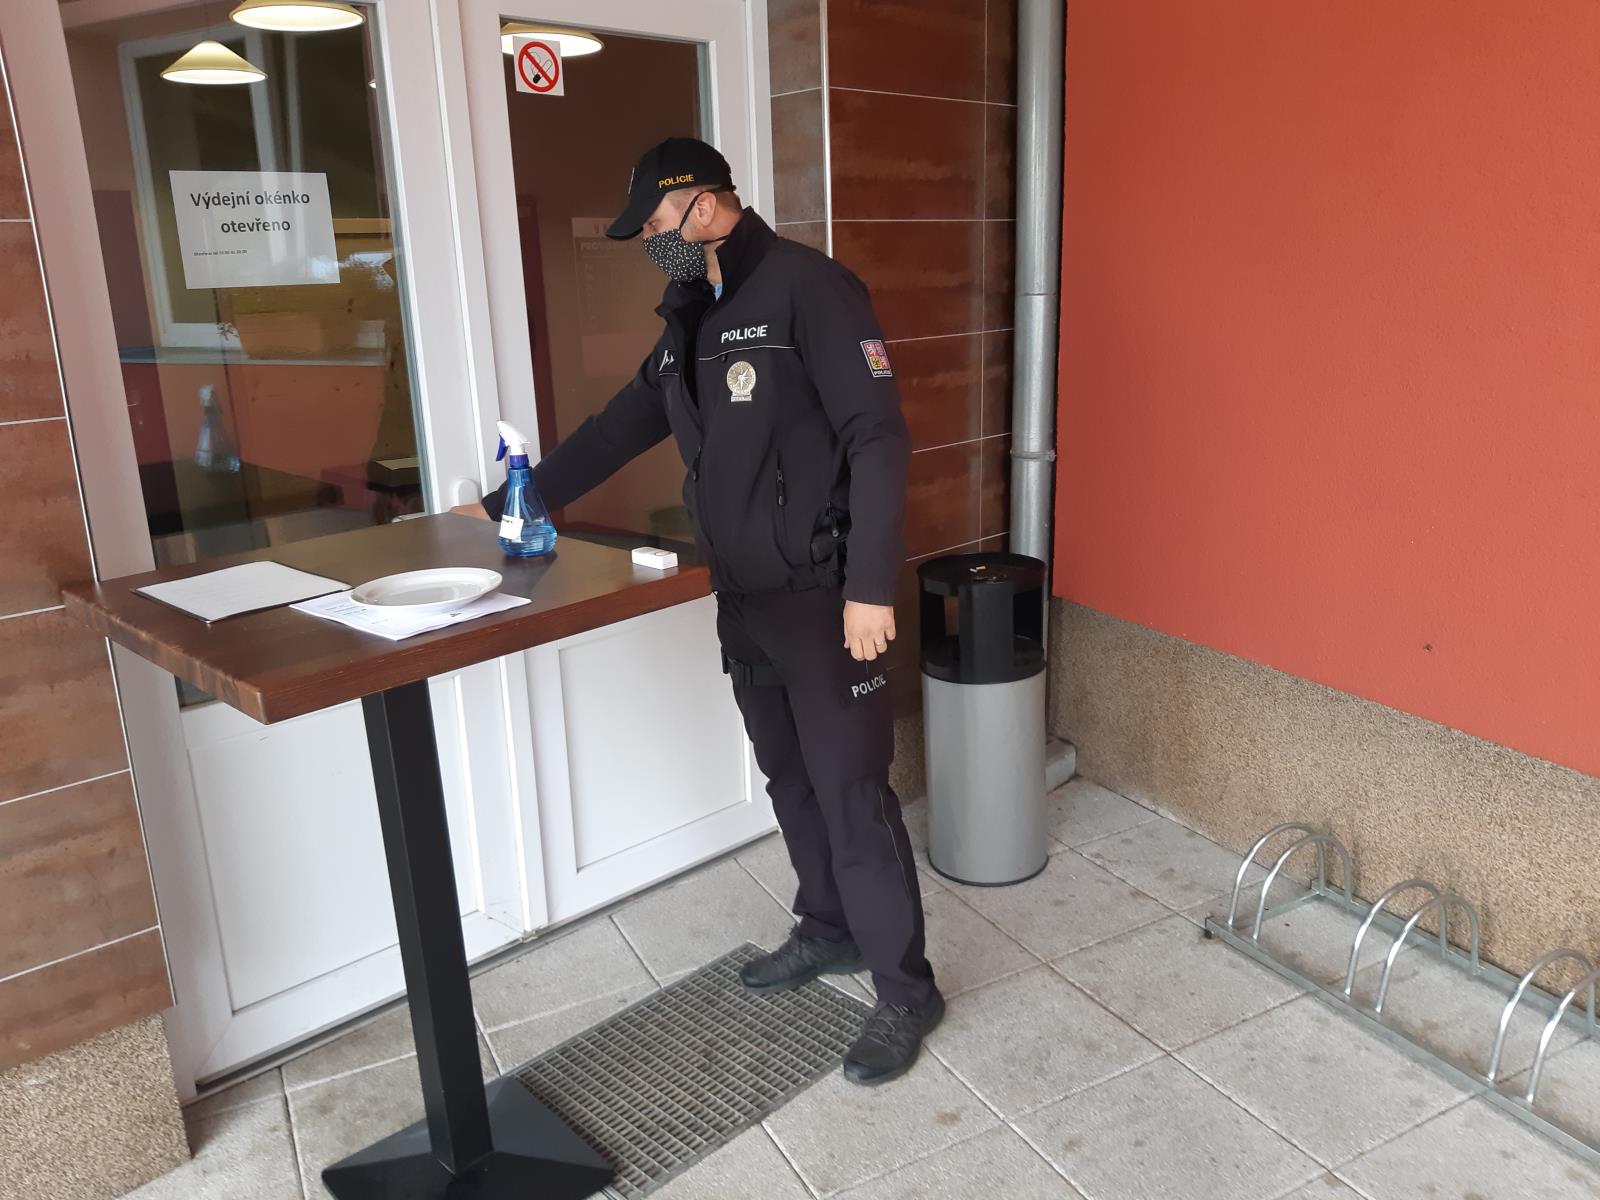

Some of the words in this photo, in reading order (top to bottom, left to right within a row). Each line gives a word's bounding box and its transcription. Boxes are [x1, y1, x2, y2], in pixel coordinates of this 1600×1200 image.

[658, 174, 695, 188] POLICIE
[190, 191, 250, 209] Výdejní
[254, 190, 310, 205] okénko
[221, 218, 290, 233] otevřeno
[721, 325, 768, 343] POLICIE
[851, 674, 886, 698] POLICIE
